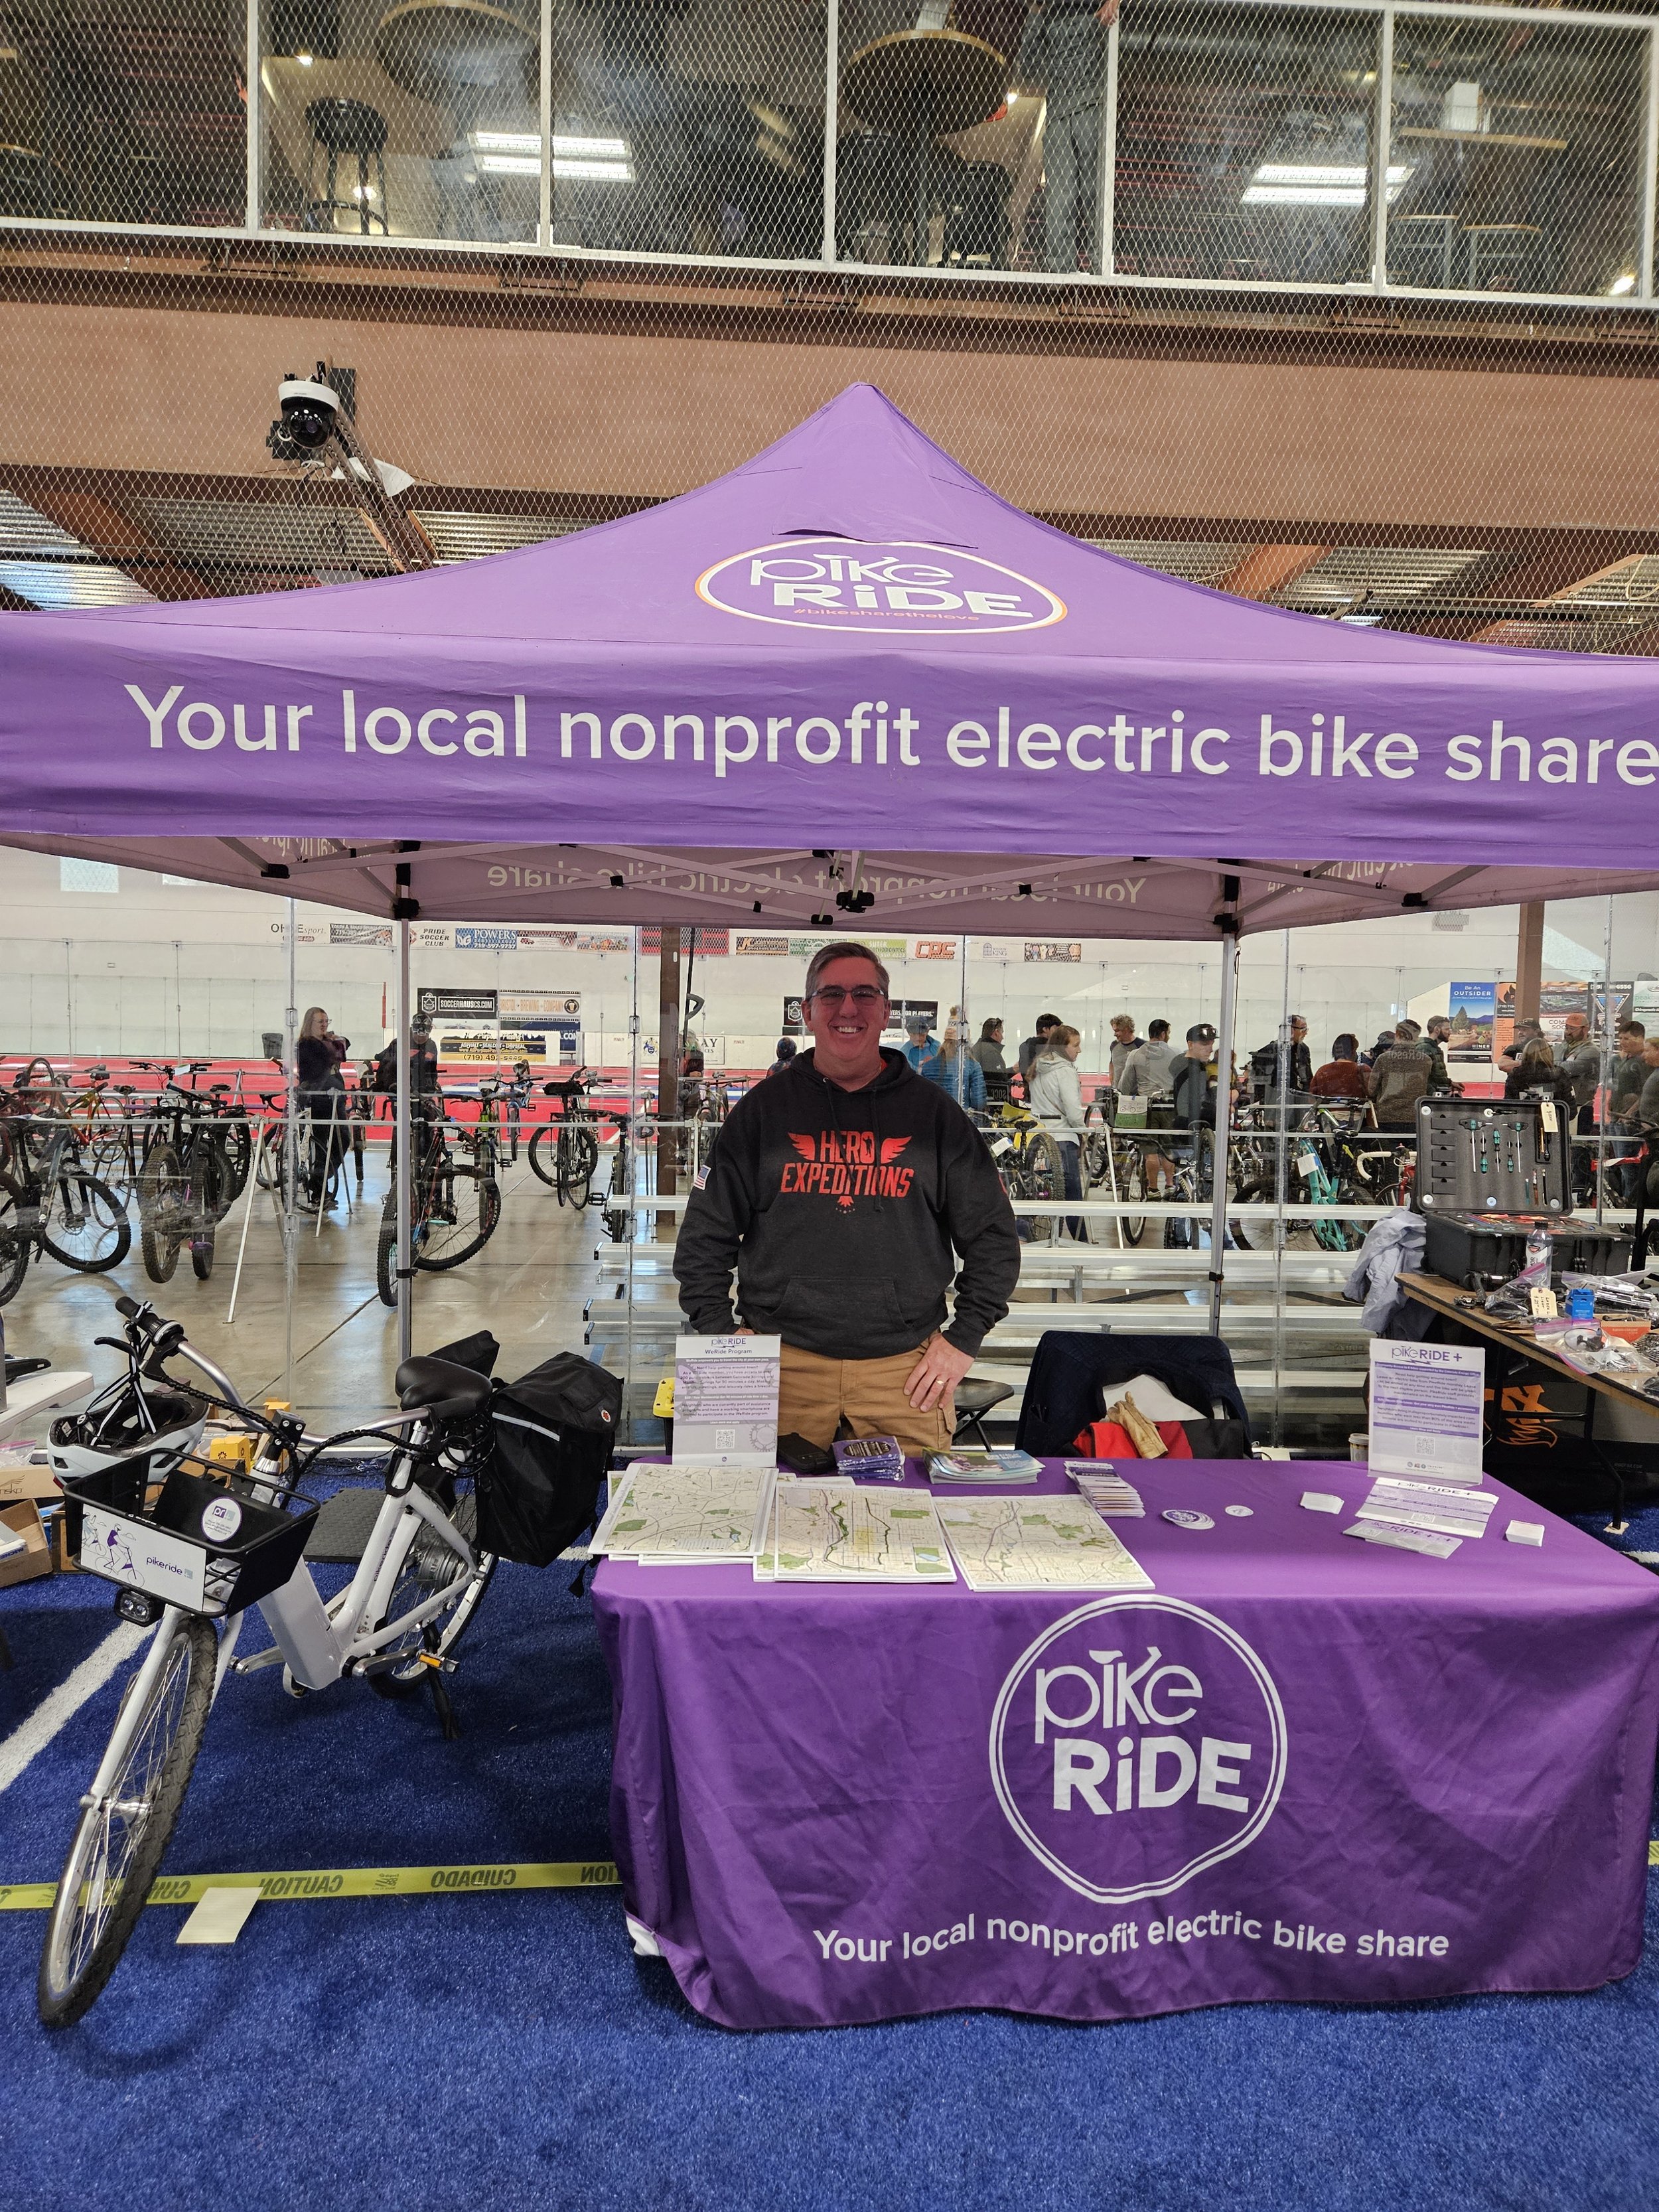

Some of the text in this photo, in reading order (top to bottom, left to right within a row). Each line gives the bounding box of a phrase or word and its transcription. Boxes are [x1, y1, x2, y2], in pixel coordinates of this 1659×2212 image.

[794, 608, 980, 621] #bikesharethelove
[123, 684, 1659, 793] Your local nonprofit electric bike share
[474, 929, 516, 940] POWERS
[520, 999, 540, 1012] BREWING
[543, 999, 563, 1013] COMPANY
[820, 1130, 875, 1165] HERO
[780, 1162, 915, 1199] EXPEDITIONS
[146, 1555, 183, 1576] pikeride
[1034, 1646, 1203, 1745] pike
[1053, 1735, 1252, 1815] RiDE
[813, 1909, 1450, 1964] Your local nonprofit electric bike share
